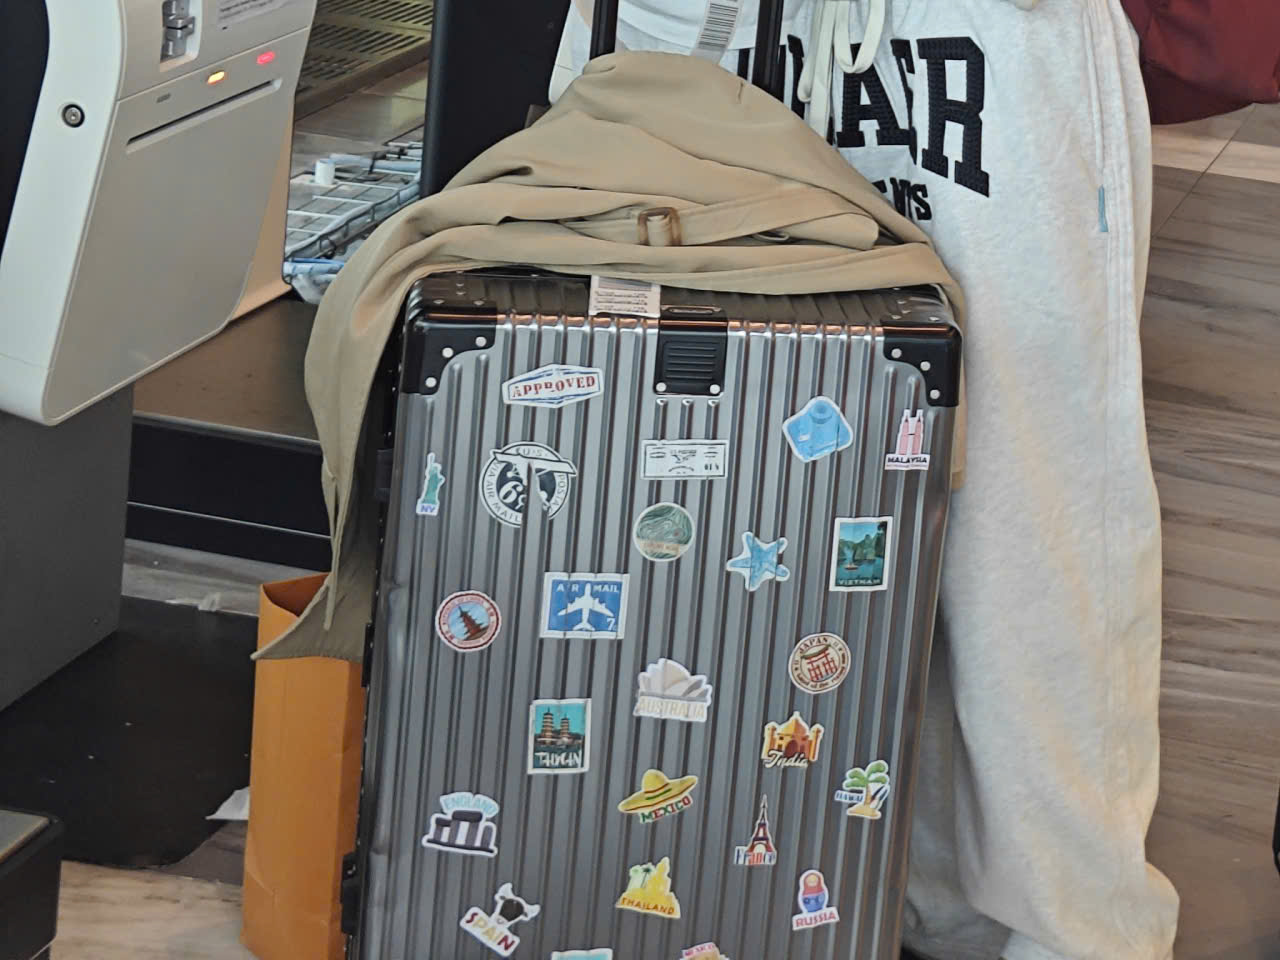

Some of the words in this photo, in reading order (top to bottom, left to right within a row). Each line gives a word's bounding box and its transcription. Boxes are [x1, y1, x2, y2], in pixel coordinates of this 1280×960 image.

[511, 376, 597, 398] APPROVED
[887, 456, 928, 464] MALAYSIA
[593, 584, 620, 593] MAIL
[764, 749, 809, 769] India
[640, 795, 692, 824] MEXICO
[621, 897, 676, 915] THAILAND
[795, 911, 837, 928] RUSSIA
[464, 911, 517, 952] SPAIN
